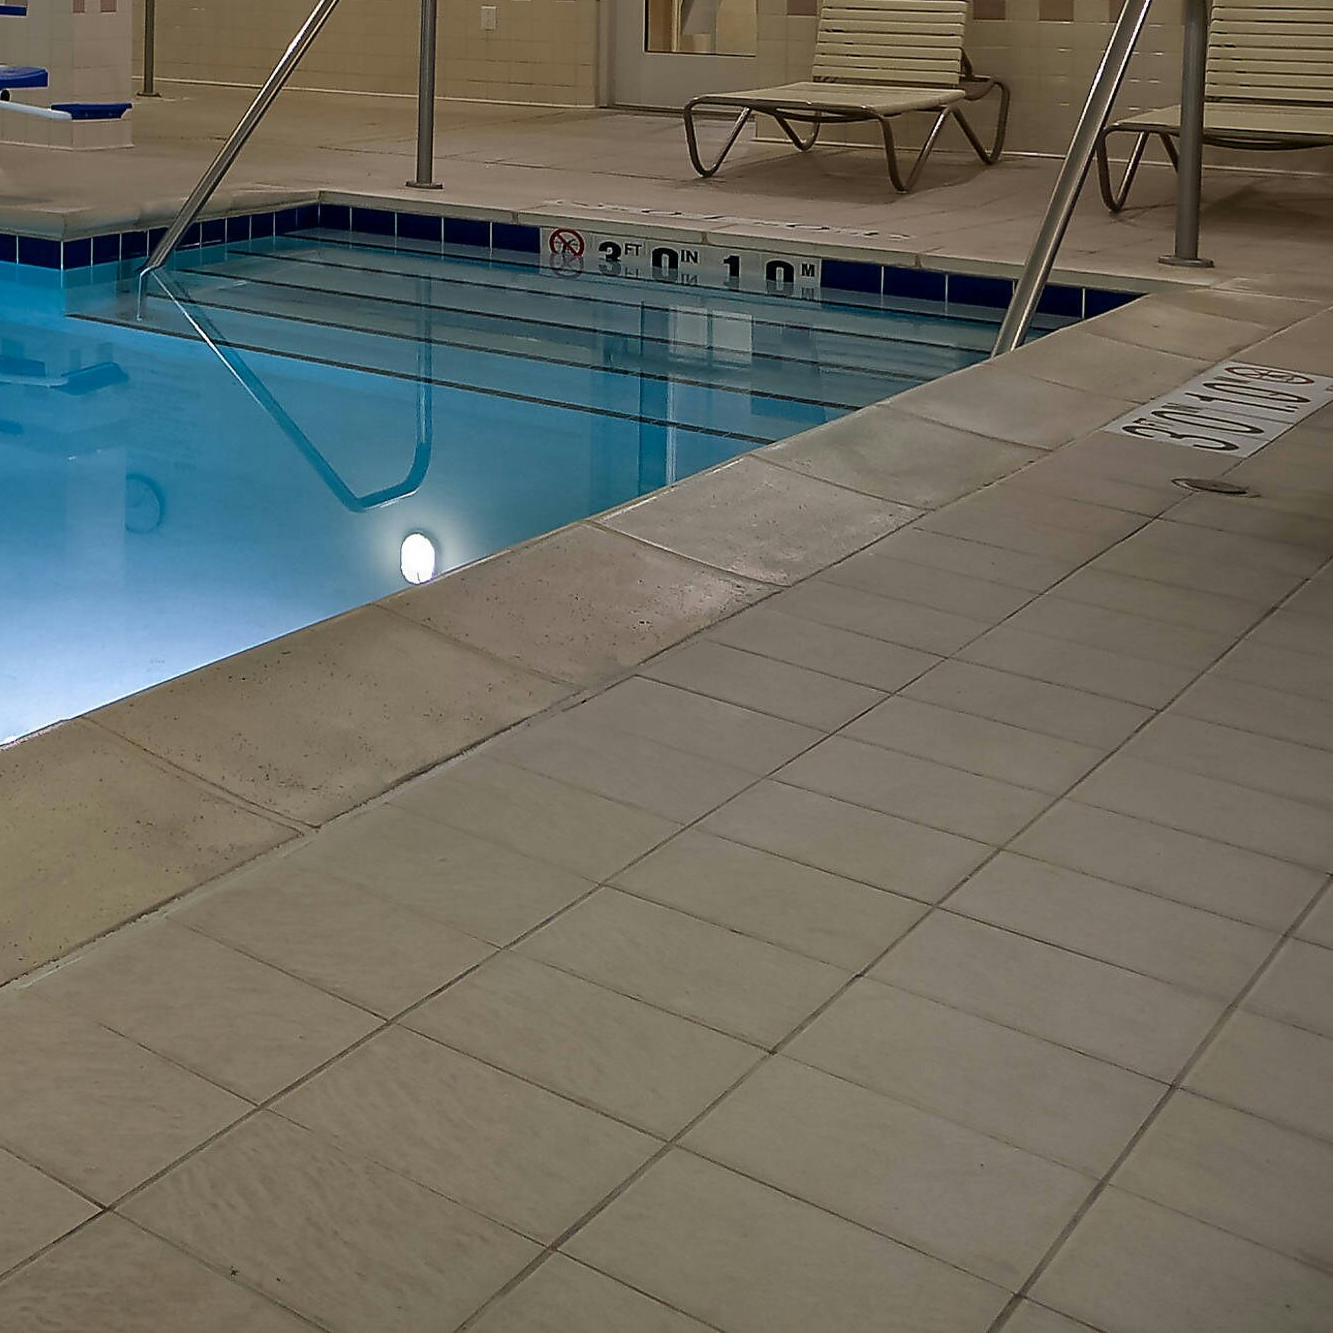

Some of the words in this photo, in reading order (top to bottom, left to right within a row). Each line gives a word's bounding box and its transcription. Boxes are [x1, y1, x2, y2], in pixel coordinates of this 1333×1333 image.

[624, 244, 643, 257] FT
[681, 249, 699, 264] IN
[801, 263, 815, 277] M
